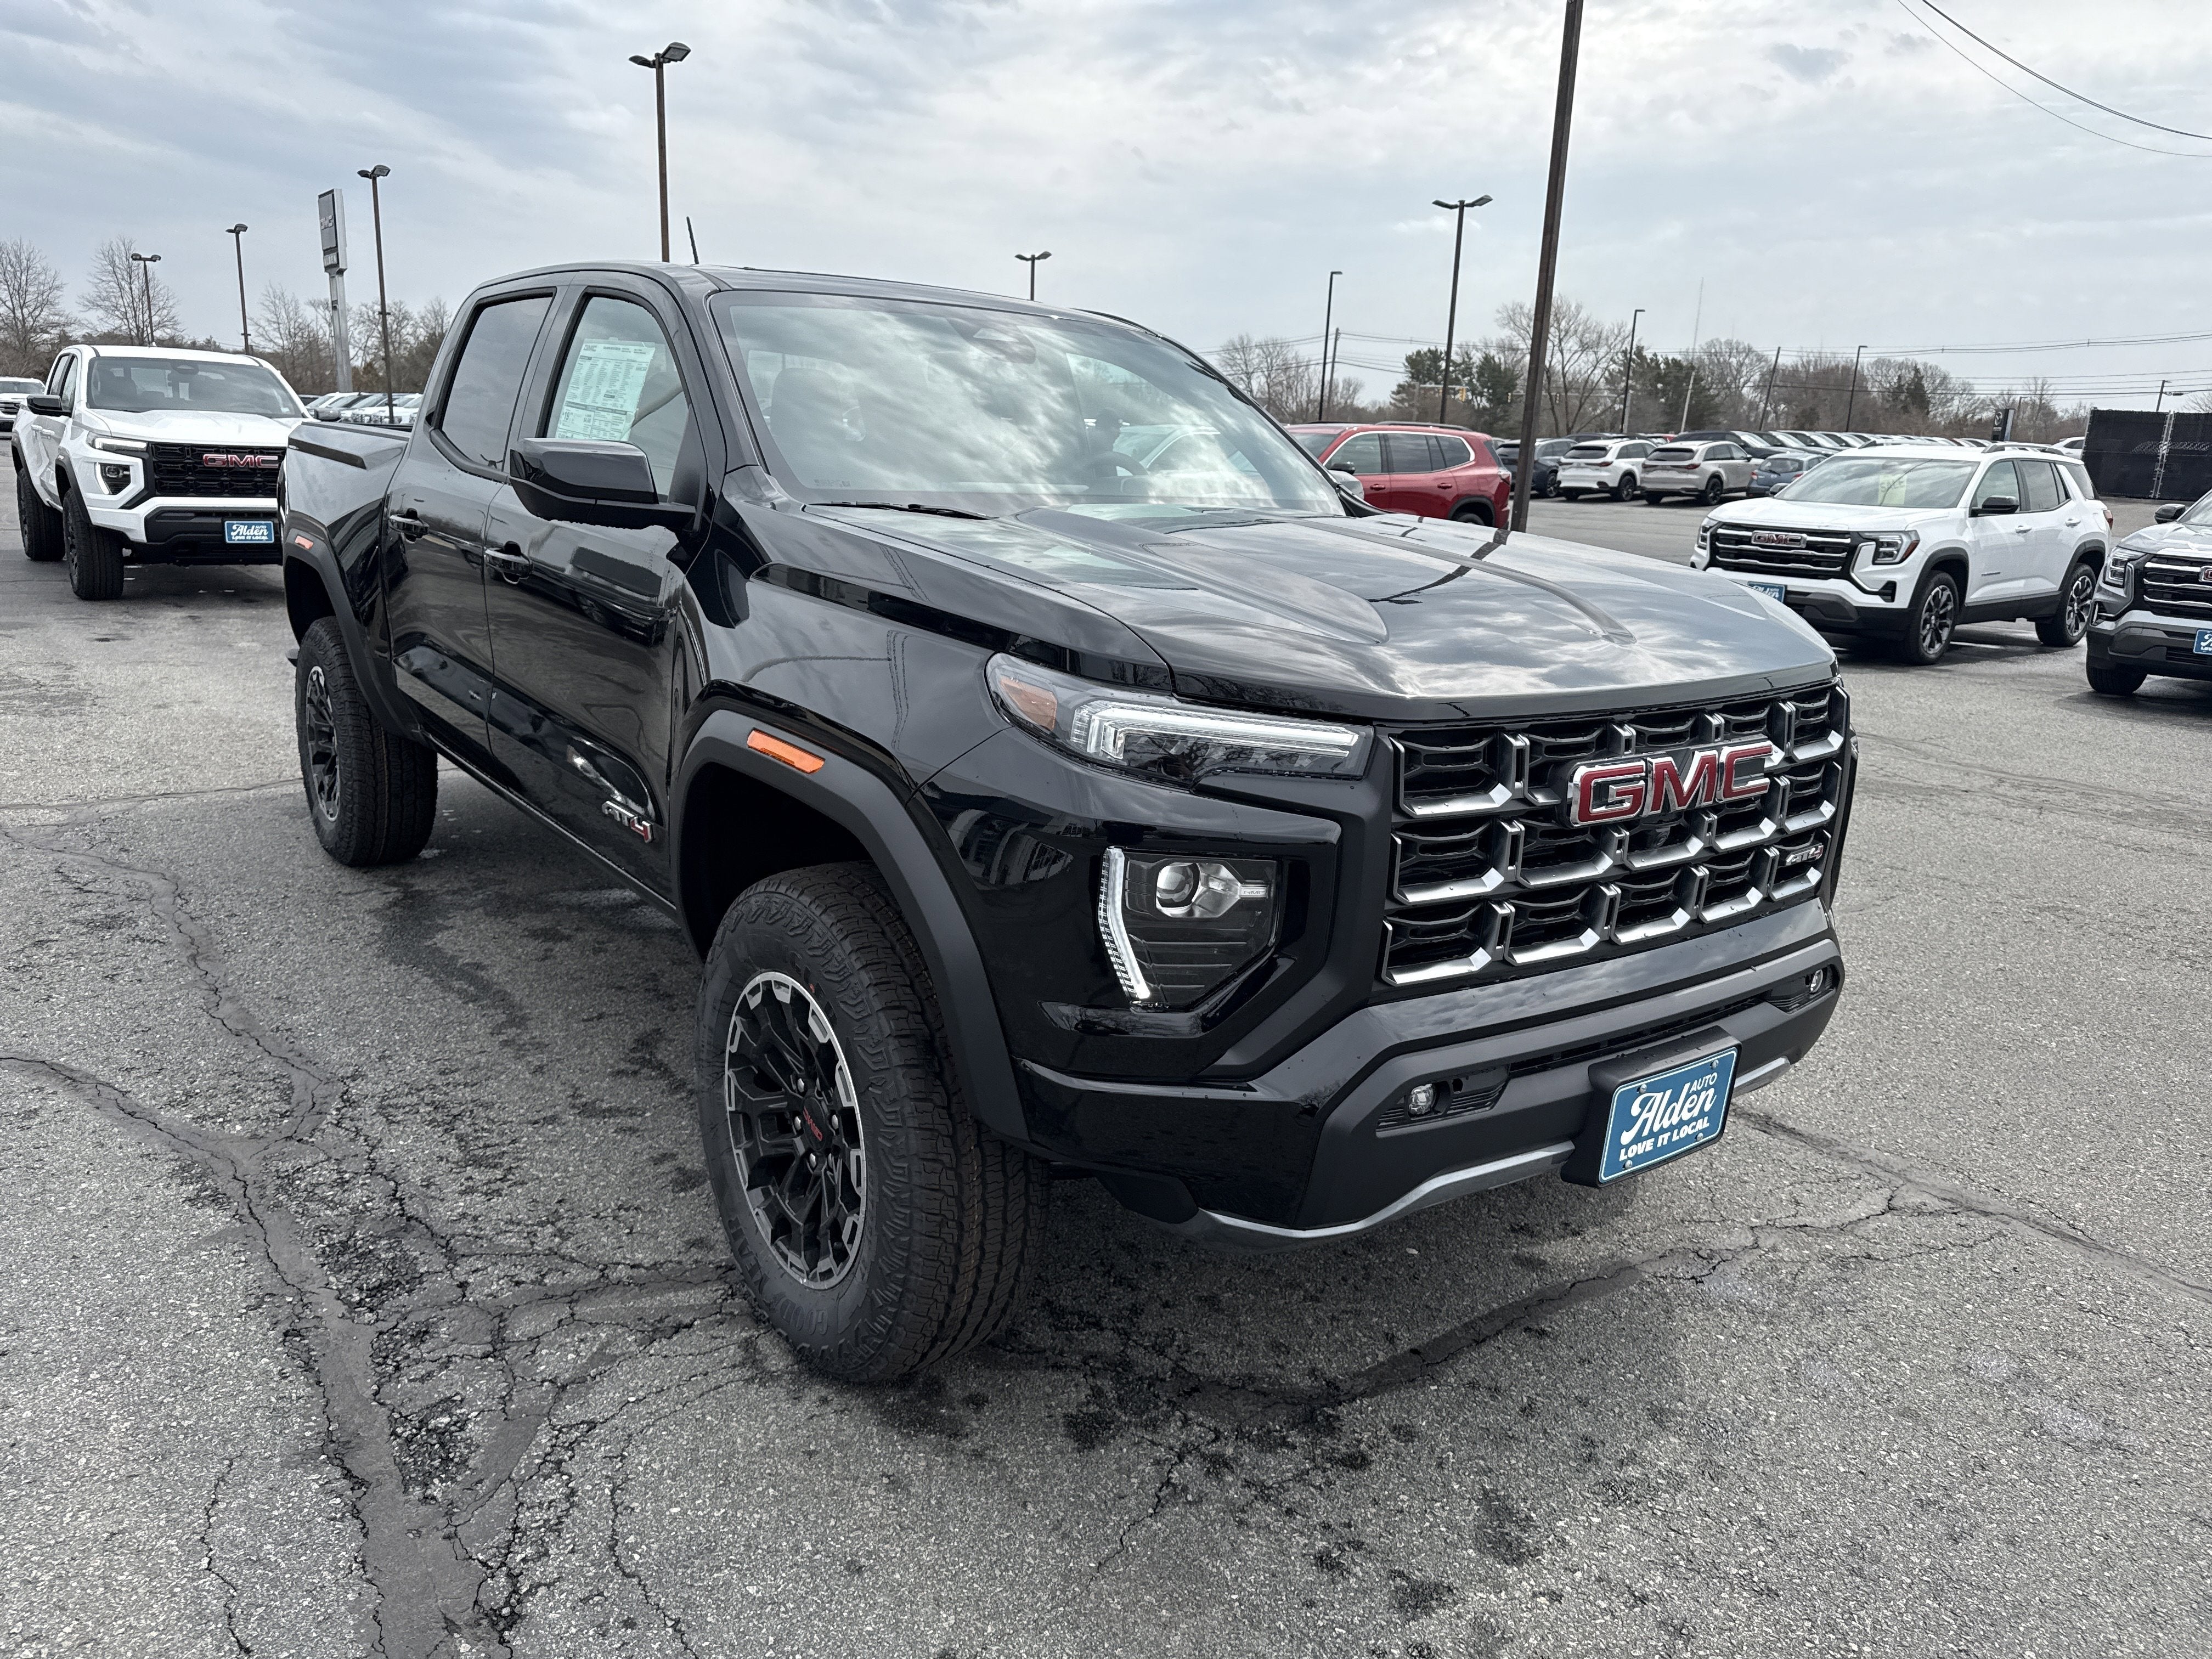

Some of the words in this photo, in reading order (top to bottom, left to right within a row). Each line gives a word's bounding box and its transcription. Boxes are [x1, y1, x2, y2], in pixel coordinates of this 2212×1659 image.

[203, 454, 279, 469] GMC
[1880, 481, 1905, 492] SALE
[231, 524, 269, 536] Alden
[1753, 533, 1802, 545] GMC
[1568, 740, 1773, 827] GMC
[602, 800, 652, 843] AT4
[1786, 845, 1824, 866] AT4
[1689, 1072, 1718, 1093] AUTO
[803, 1105, 823, 1142] GMC
[1620, 1082, 1717, 1146] Alden
[1619, 1138, 1654, 1161] LOVE
[1657, 1132, 1671, 1148] IT
[1672, 1116, 1709, 1141] LOCAL
[728, 1216, 828, 1335] GOODYEAR
